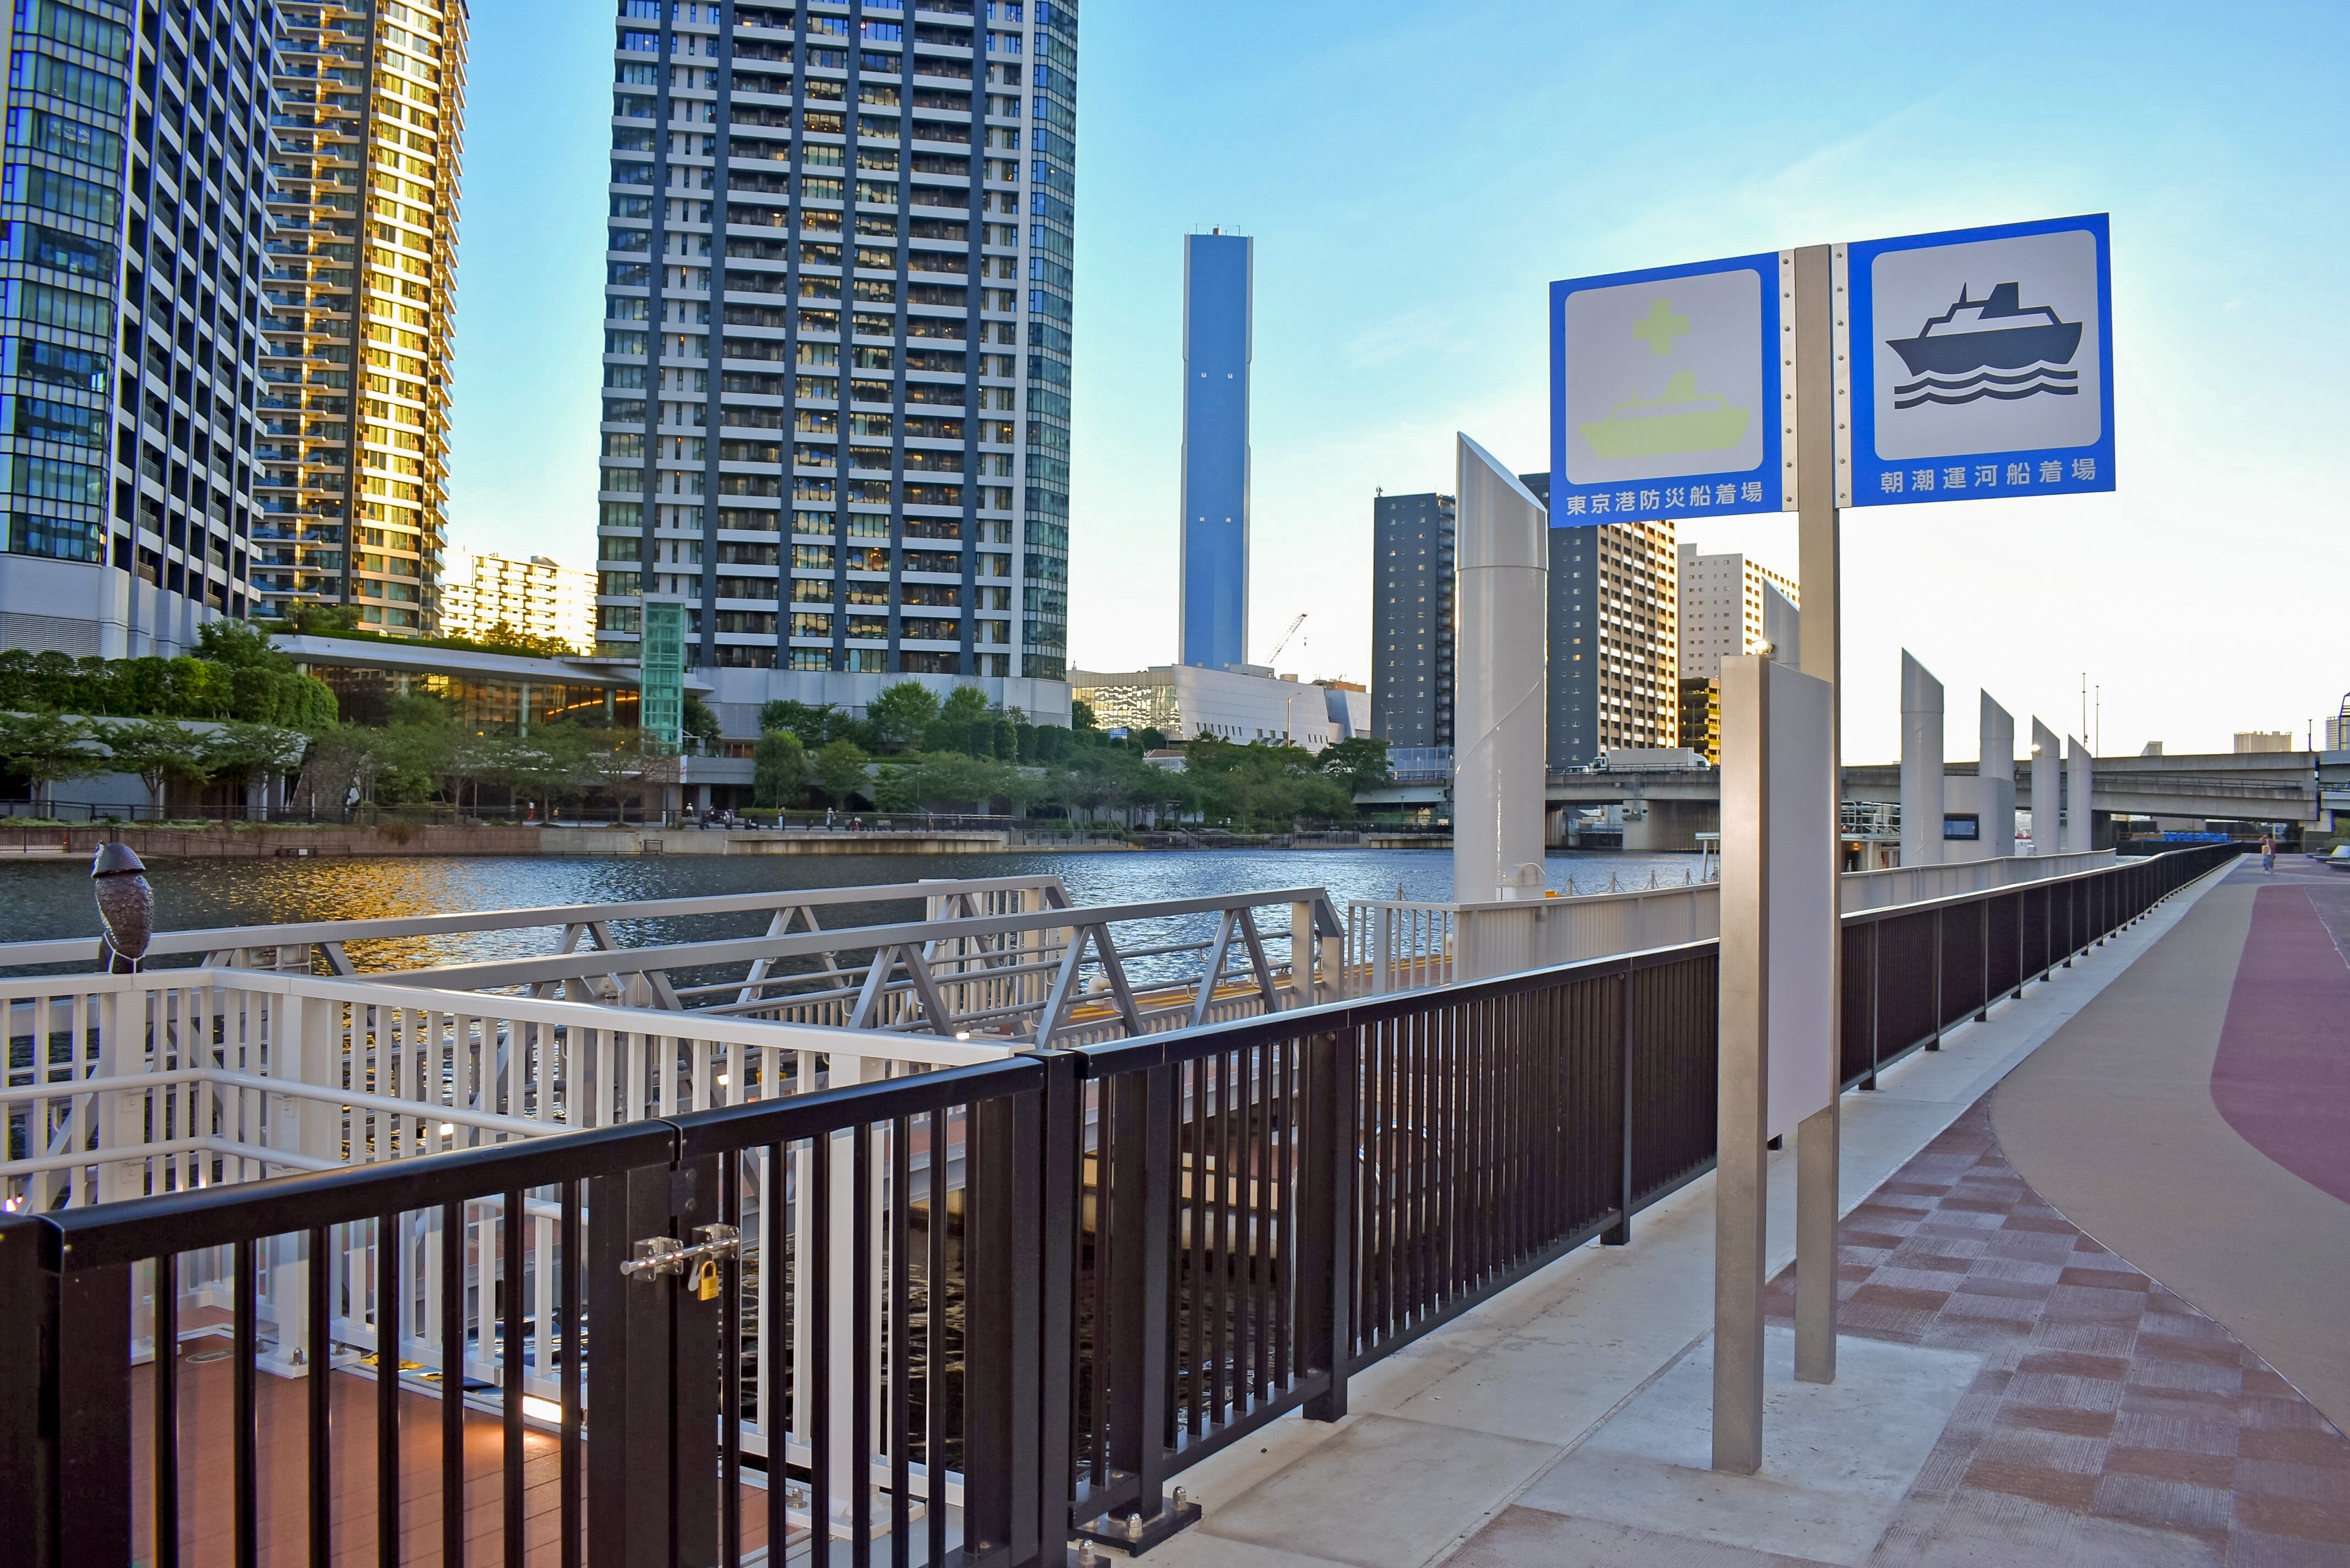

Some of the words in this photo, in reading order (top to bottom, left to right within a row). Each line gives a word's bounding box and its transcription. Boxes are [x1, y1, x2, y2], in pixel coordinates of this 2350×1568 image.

[1881, 458, 2096, 493] 朝潮運河船着場
[1566, 481, 1763, 516] 東京港防災船着場
